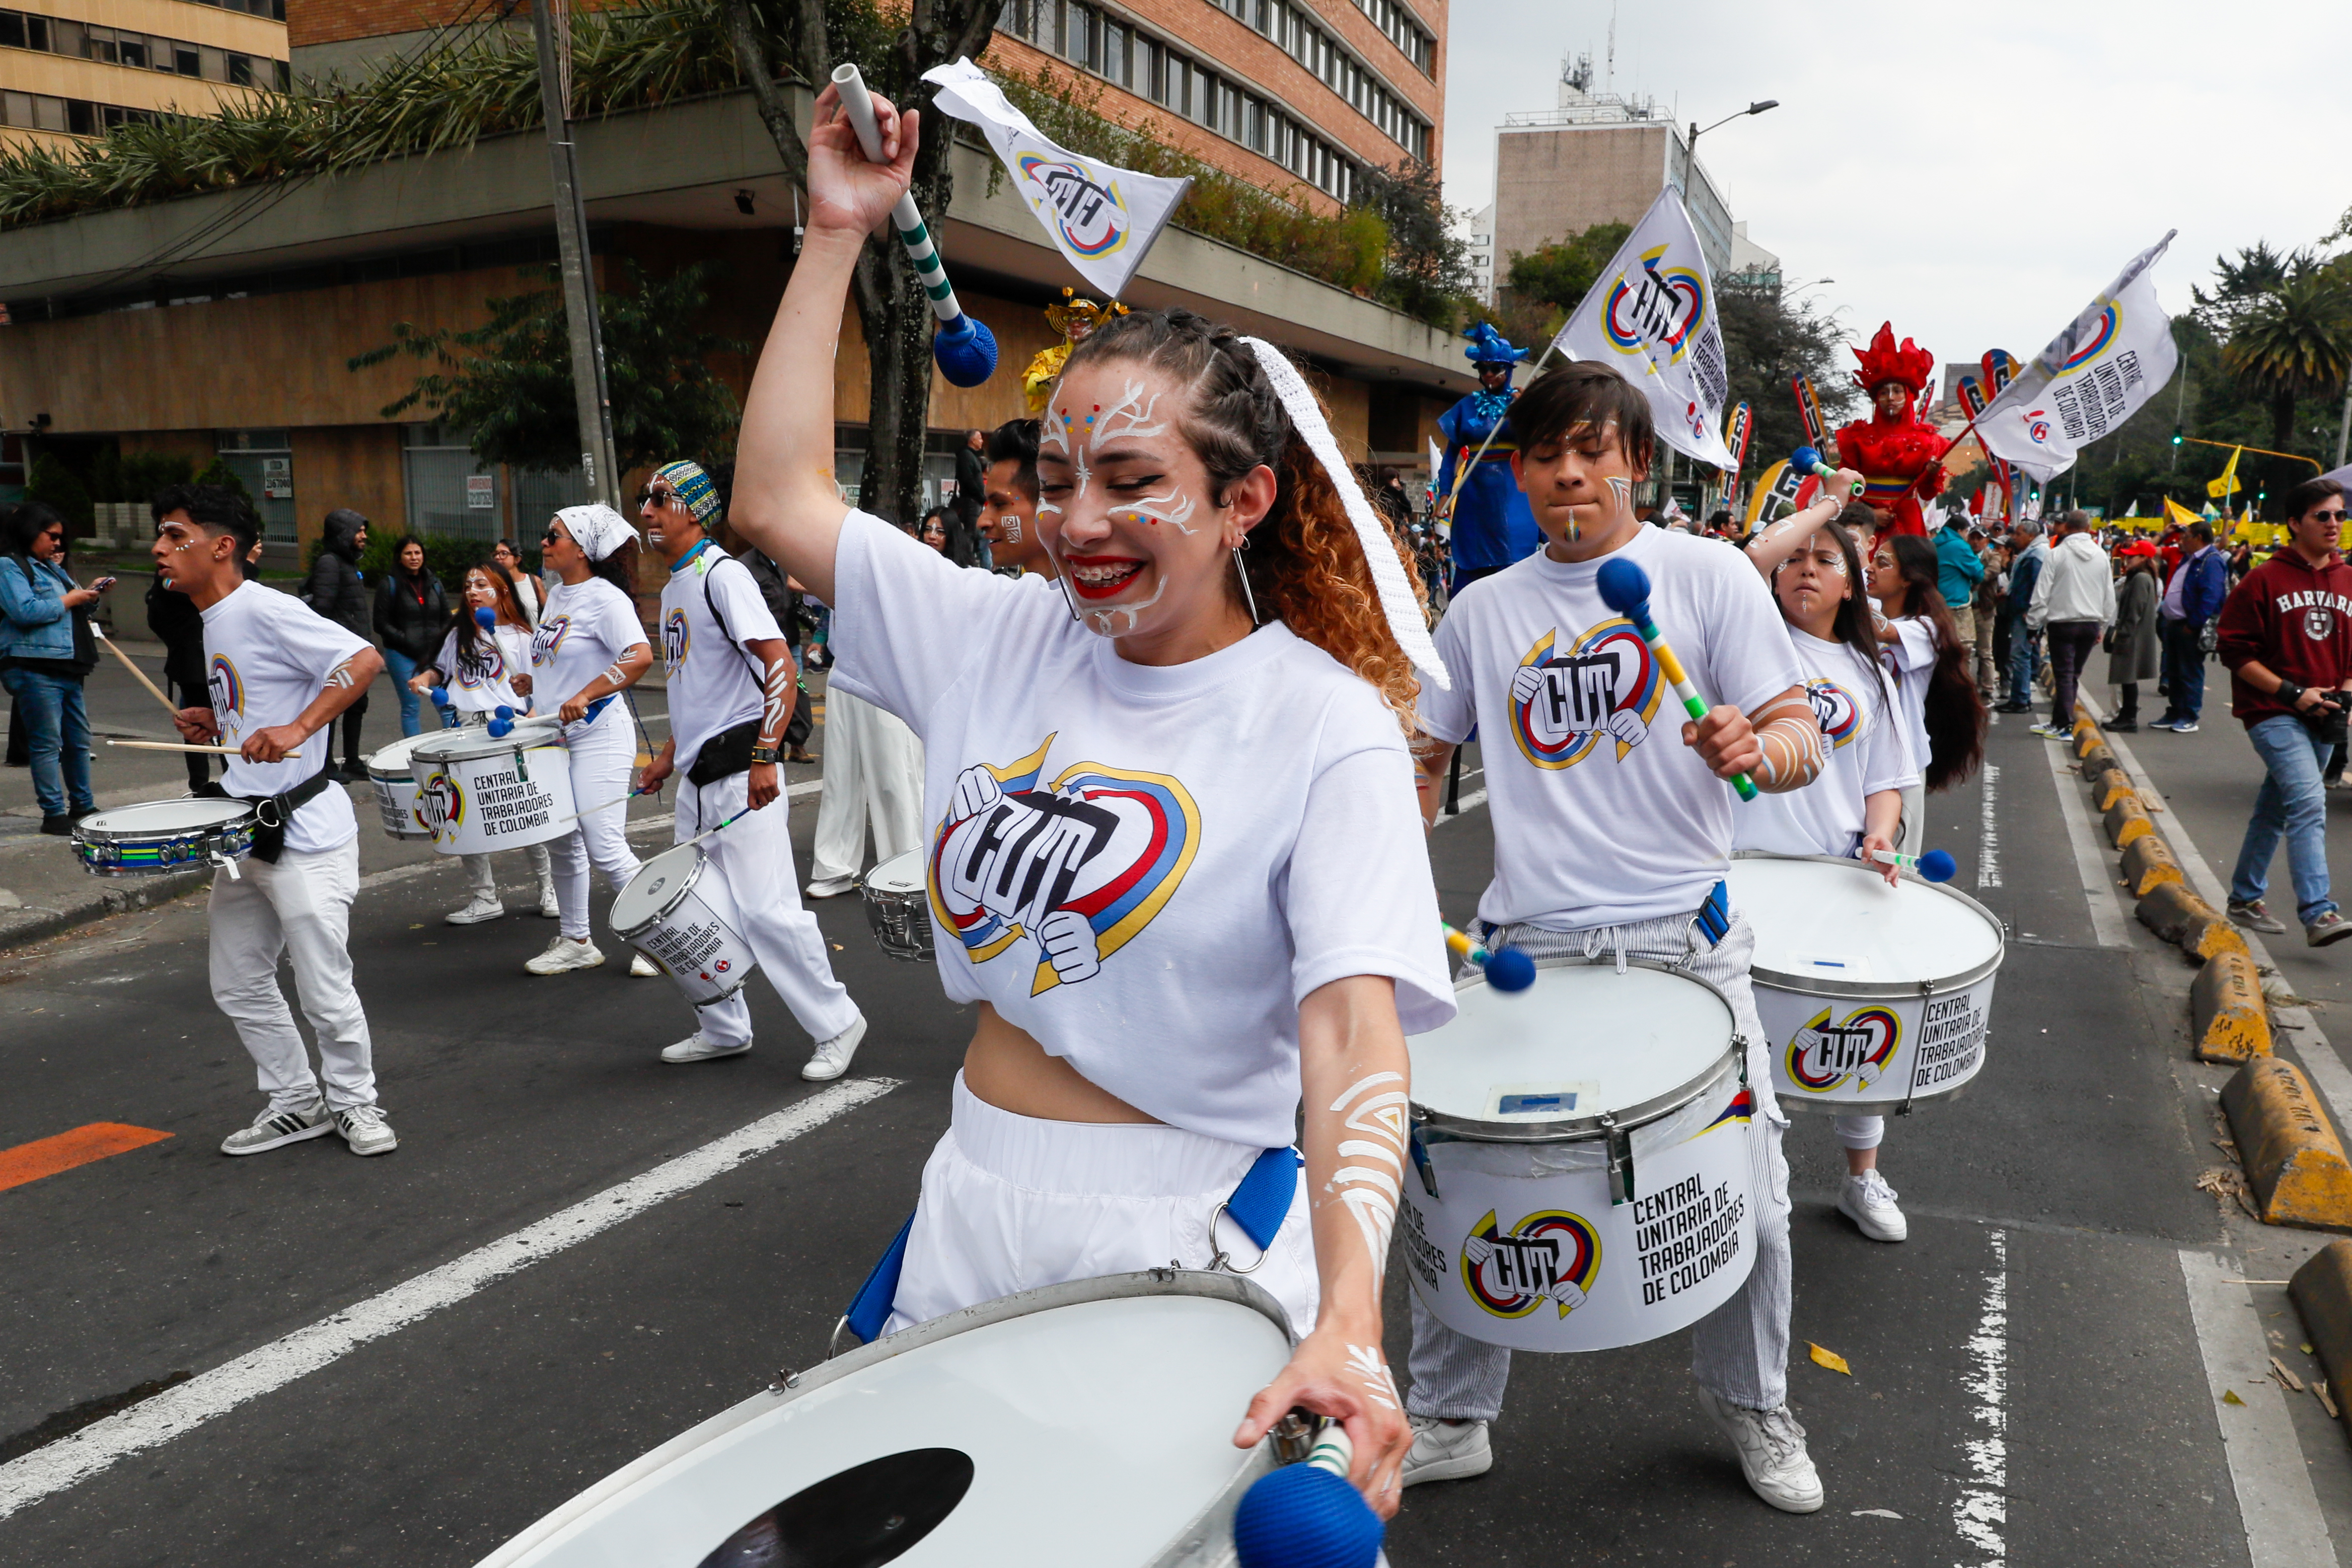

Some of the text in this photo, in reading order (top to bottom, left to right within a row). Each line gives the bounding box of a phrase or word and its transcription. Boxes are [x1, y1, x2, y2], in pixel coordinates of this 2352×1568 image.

[2053, 385, 2085, 439] DE COLOMBIA
[2074, 372, 2107, 440] TRABAJADORES
[2094, 361, 2126, 419] UNITARIA DE
[1540, 652, 1620, 733] CUT
[474, 771, 519, 790] CENTRAL
[477, 781, 539, 805] UNITARIA DE
[480, 793, 553, 821] TRABAJADORES
[484, 811, 550, 836] DE COLOMBIA
[952, 791, 1120, 932] CUT
[647, 926, 681, 950] CENTRAL
[688, 922, 702, 936] DE
[675, 964, 689, 976] DE
[1923, 1007, 1981, 1044] UNITARIA DE
[1927, 994, 1970, 1022] CENTRAL
[1813, 1028, 1873, 1073] CUT
[1921, 1022, 1985, 1066] TRABAJADORES
[1916, 1048, 1977, 1087] DE COLOMBIA
[1413, 1205, 1426, 1236] DE
[1633, 1173, 1705, 1225] CENTRAL
[1637, 1180, 1729, 1252] UNITARIA DE
[1639, 1193, 1744, 1279] TRABAJADORES
[1490, 1237, 1560, 1296] CUT
[1643, 1230, 1739, 1306] DE COLOMBIA
